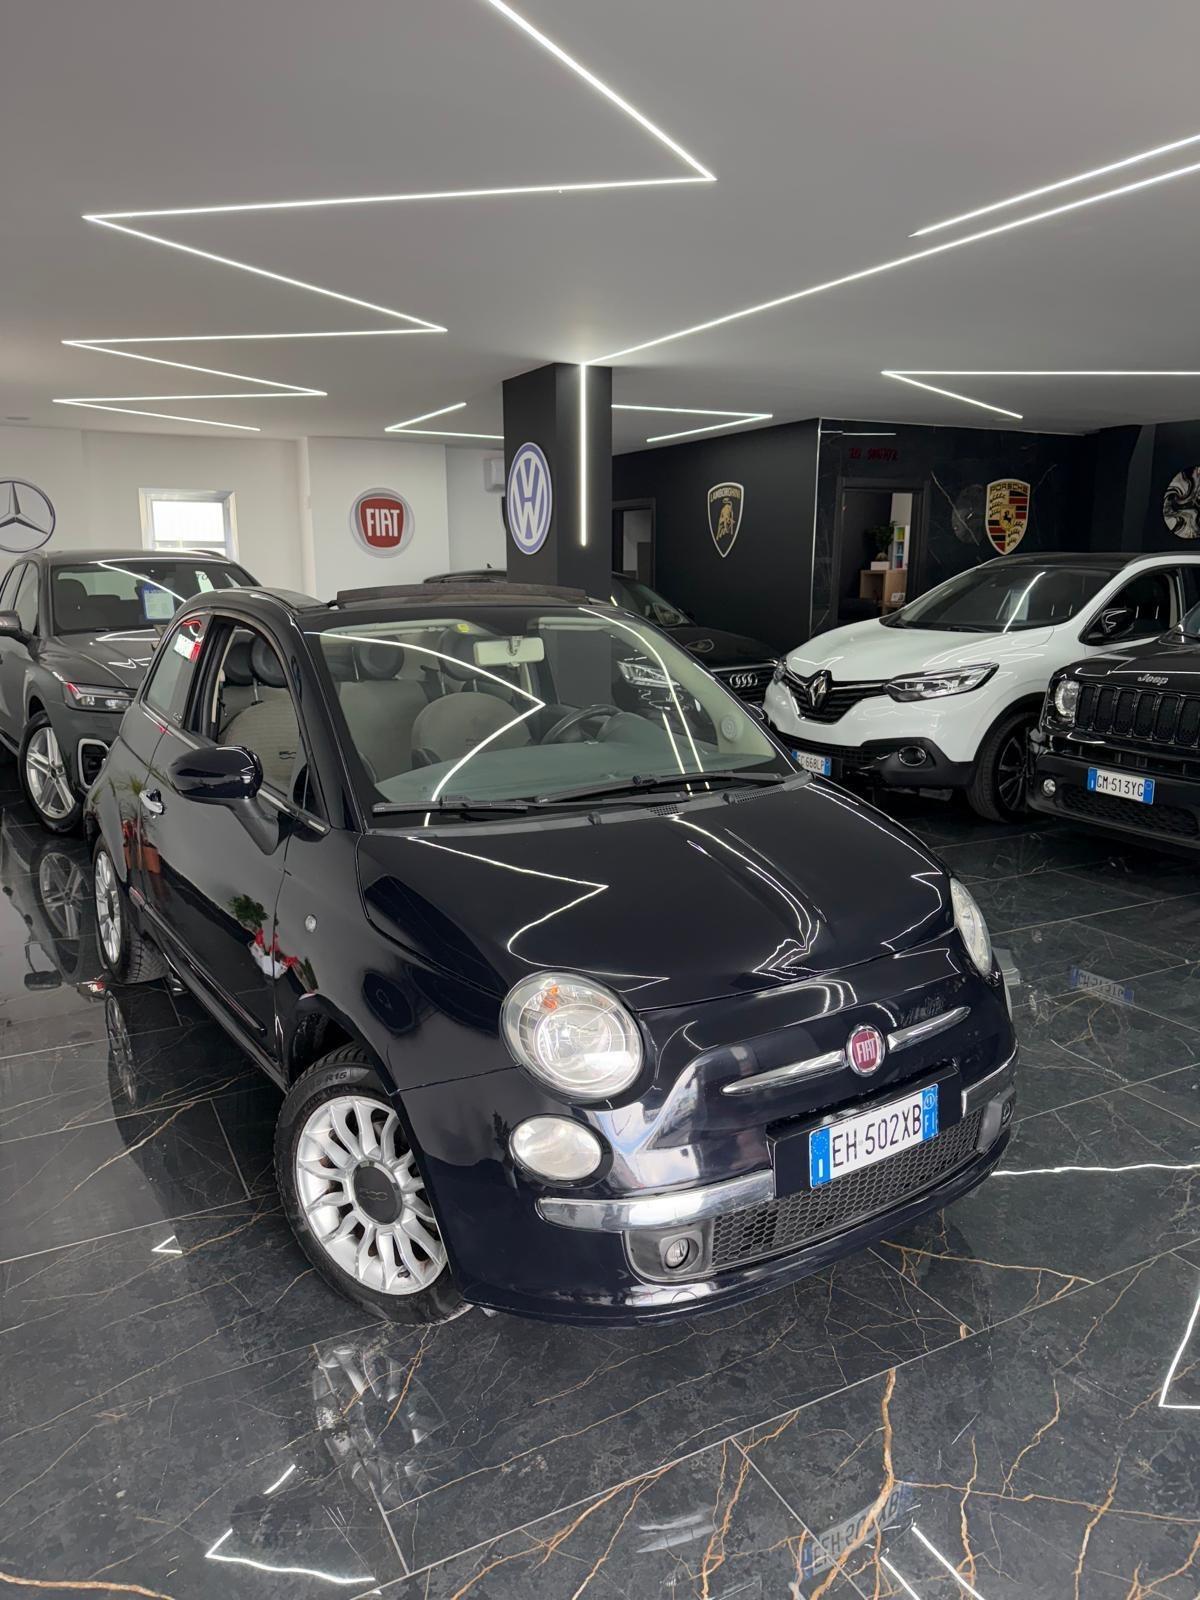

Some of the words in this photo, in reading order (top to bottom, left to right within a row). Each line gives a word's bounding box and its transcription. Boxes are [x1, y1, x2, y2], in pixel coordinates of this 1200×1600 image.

[366, 508, 400, 537] FIAT
[1137, 673, 1169, 686] Jeep
[856, 1037, 876, 1063] FIAT
[832, 1128, 858, 1168] EH
[865, 1104, 922, 1155] 502XB
